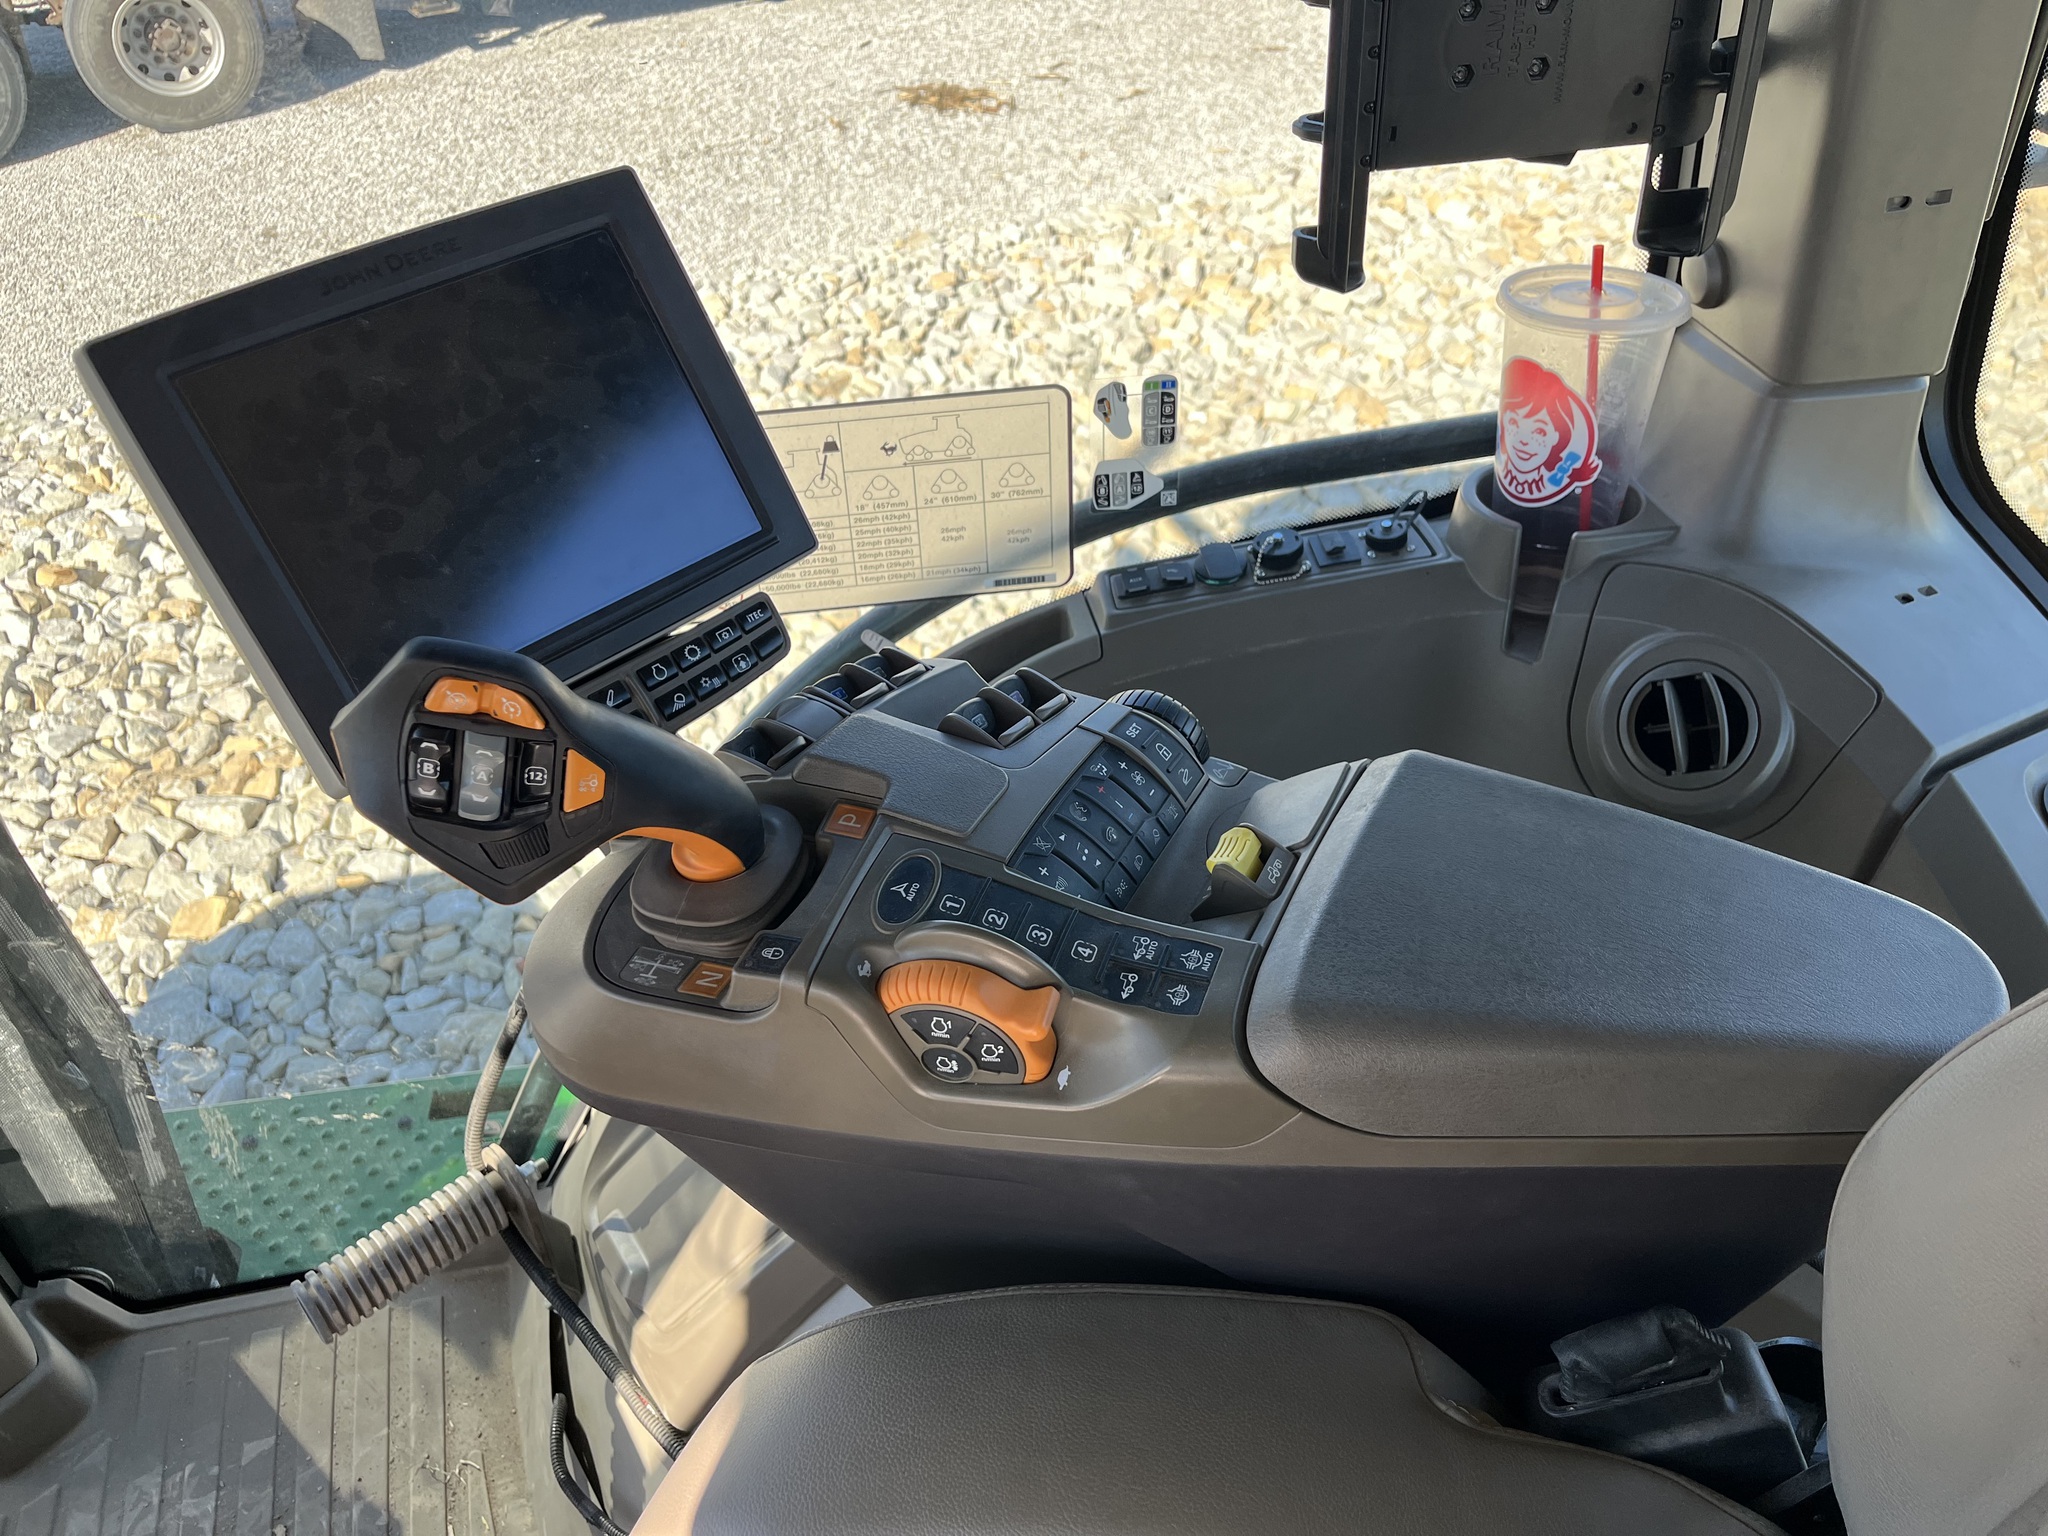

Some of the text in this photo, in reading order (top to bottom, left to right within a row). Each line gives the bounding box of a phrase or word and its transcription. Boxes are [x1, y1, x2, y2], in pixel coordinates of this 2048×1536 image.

[320, 235, 463, 297] JOHN DEERE
[1008, 488, 1044, 498] (762mm)
[942, 494, 977, 505] (610mm)
[873, 500, 908, 512] (457mm)
[854, 512, 910, 524] 26mph (42kph)
[855, 524, 912, 536] 25mph (40kph)
[856, 536, 912, 548] 22mph (35kph)
[858, 548, 914, 560] 20mph (32kph)
[1125, 722, 1142, 738] SET
[422, 762, 435, 774] B
[476, 771, 488, 781] A
[528, 771, 543, 781] 12
[837, 813, 862, 828] P
[905, 883, 920, 902] AUTO
[988, 914, 1004, 926] 2
[1032, 930, 1047, 942] 3
[1077, 946, 1093, 958] 4
[1145, 940, 1158, 960] AUTO
[1202, 952, 1214, 972] AUTO
[695, 970, 724, 988] N
[997, 1045, 1004, 1054] 2
